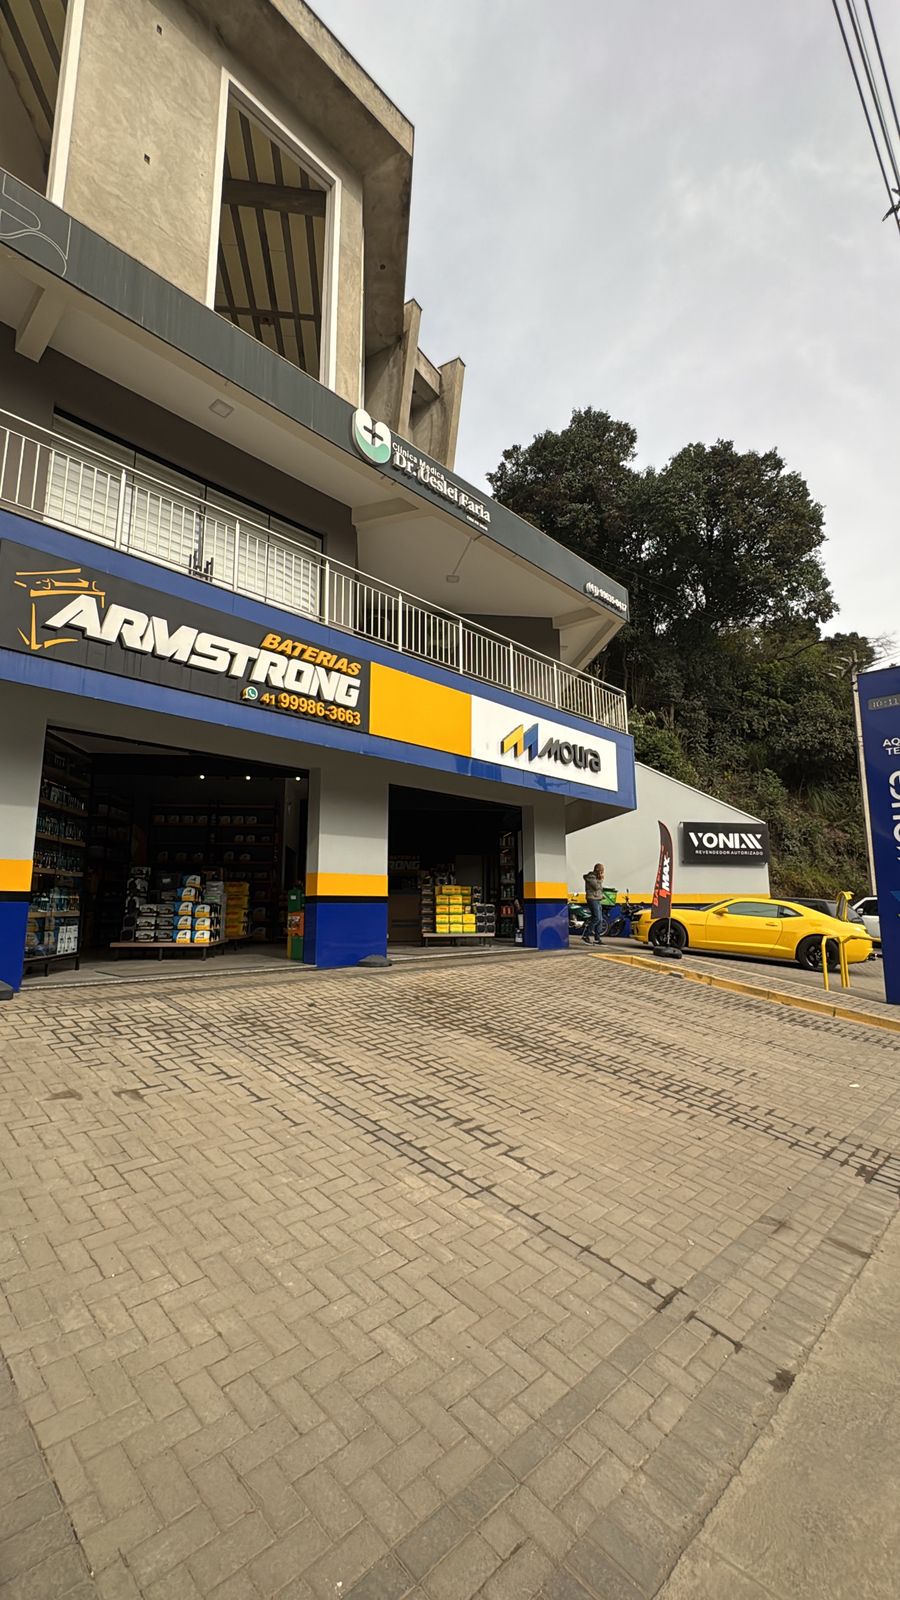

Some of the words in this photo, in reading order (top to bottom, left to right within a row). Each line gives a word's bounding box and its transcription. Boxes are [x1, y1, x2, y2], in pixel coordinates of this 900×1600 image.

[394, 450, 417, 477] Dr.
[418, 464, 458, 502] Ueslei
[459, 492, 491, 523] Faria
[42, 594, 361, 708] ARMSTRONG
[260, 633, 362, 676] BATERIAS
[260, 692, 276, 706] 41
[278, 692, 361, 726] 99986-3663
[688, 831, 764, 850] VONIXX
[661, 854, 671, 891] MAX
